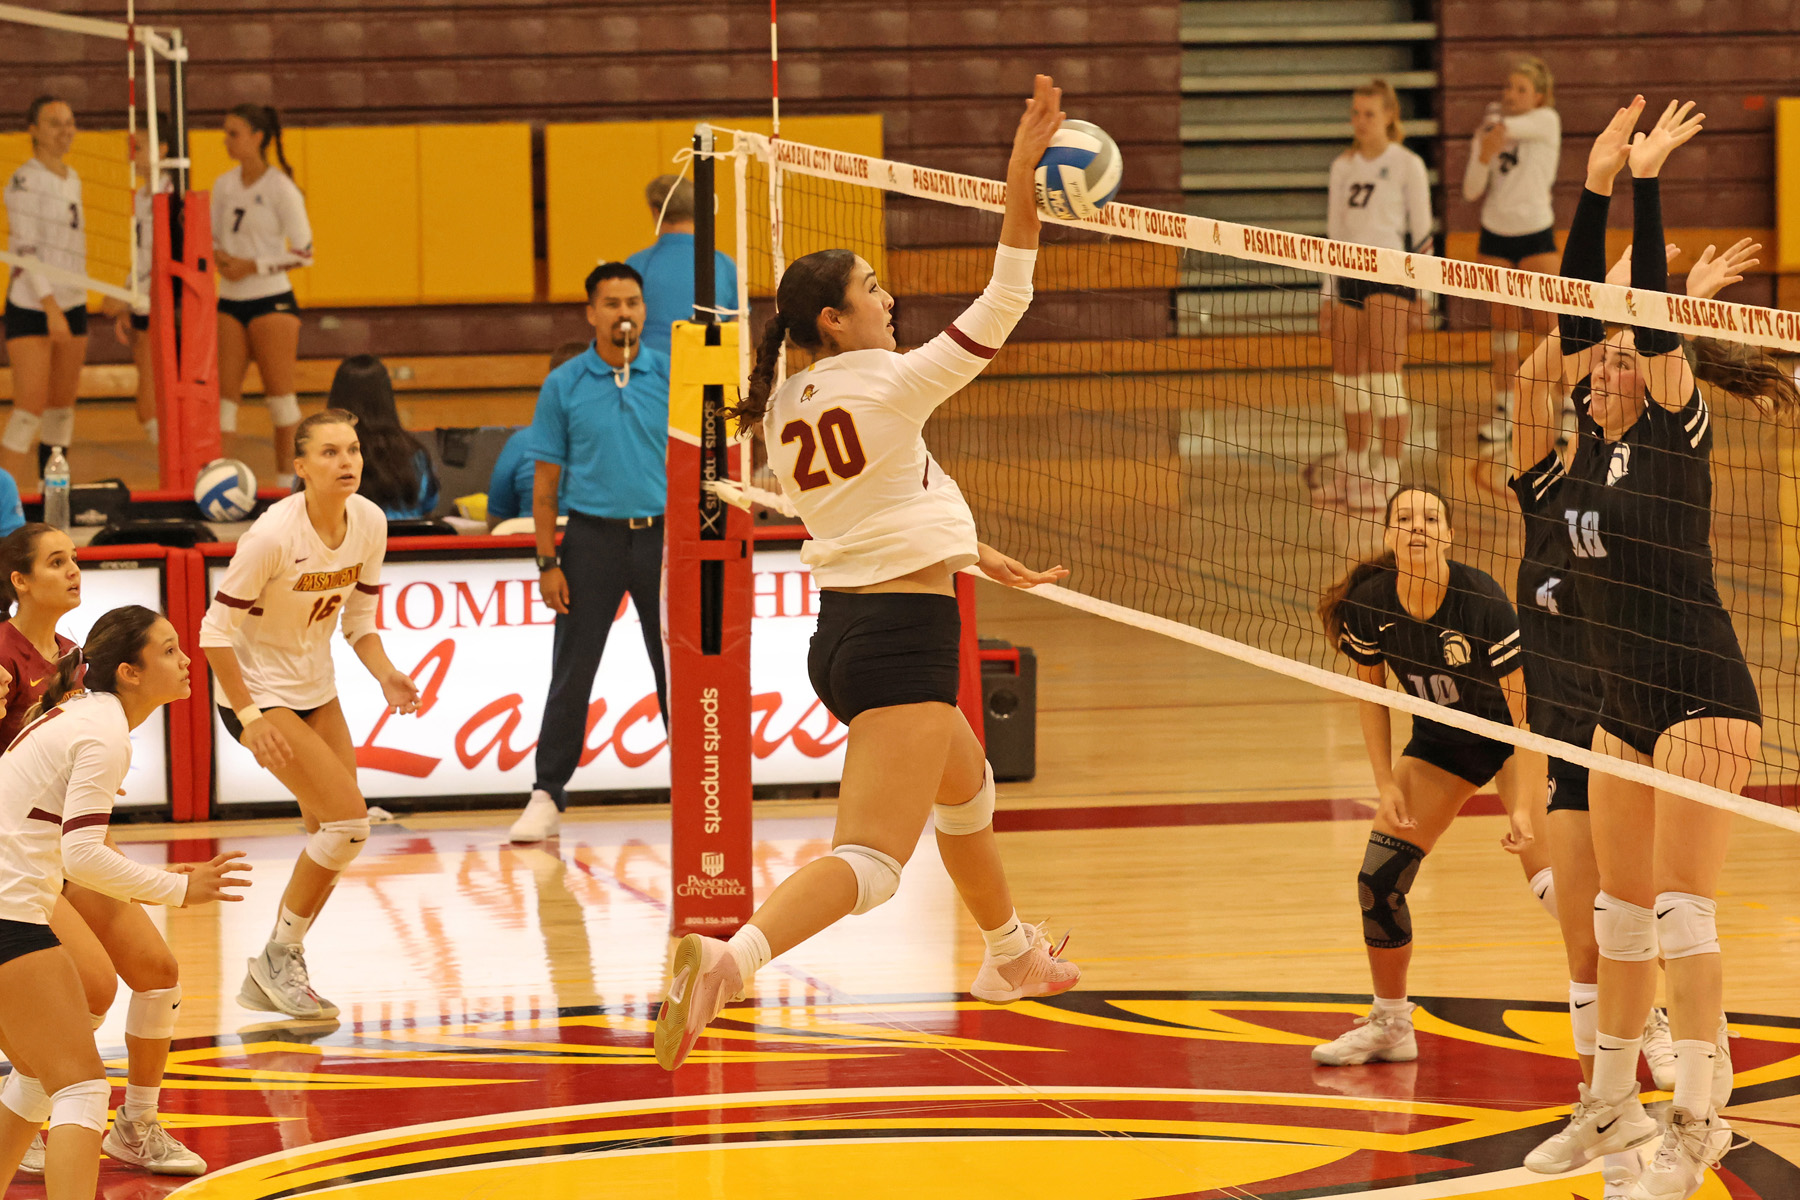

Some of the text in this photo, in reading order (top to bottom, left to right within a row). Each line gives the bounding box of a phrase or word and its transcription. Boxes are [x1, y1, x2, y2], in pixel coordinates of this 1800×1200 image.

[912, 168, 956, 197] PASADENA
[959, 177, 979, 201] CITY
[1348, 183, 1375, 208] 27
[232, 207, 246, 233] 7
[1145, 211, 1188, 240] COLLEGE
[1243, 228, 1378, 273] PASADENA CITY COLLEGE
[1440, 260, 1595, 309] PASADENA CITY COLLEGE
[1666, 296, 1738, 331] PASADENA
[1740, 307, 1773, 336] CITY
[703, 400, 717, 450] sports
[780, 405, 868, 493] 20
[306, 594, 342, 628] 16
[1407, 673, 1460, 706] 10
[700, 687, 722, 834] sports imports
[676, 883, 746, 899] CITY COLLEGE
[687, 874, 741, 888] PASADENA
